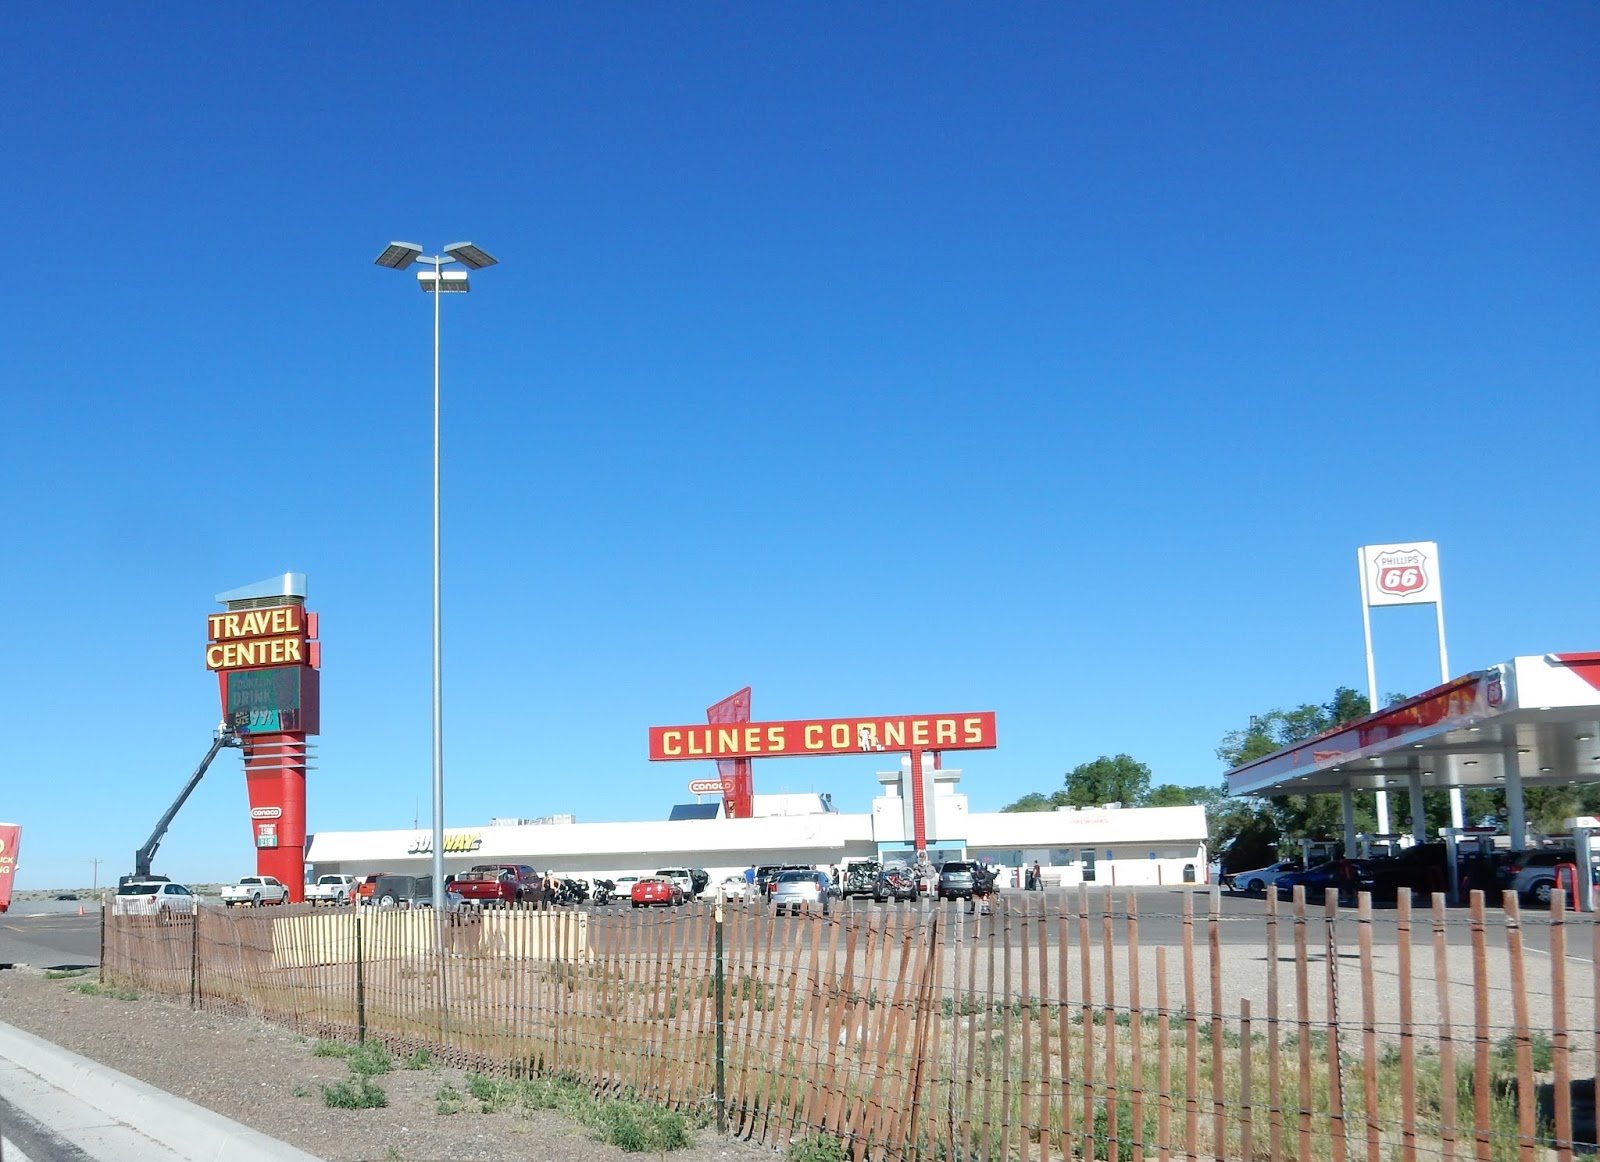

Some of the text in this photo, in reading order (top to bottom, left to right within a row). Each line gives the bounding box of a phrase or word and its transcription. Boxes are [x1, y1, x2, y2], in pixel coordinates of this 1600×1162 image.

[1382, 556, 1419, 566] PHILLIPS
[1384, 568, 1419, 588] 66
[208, 608, 300, 639] TRAVEL
[206, 638, 302, 668] CENTER
[663, 718, 982, 755] CLINES CORNERS
[407, 833, 482, 854] SUWAY
